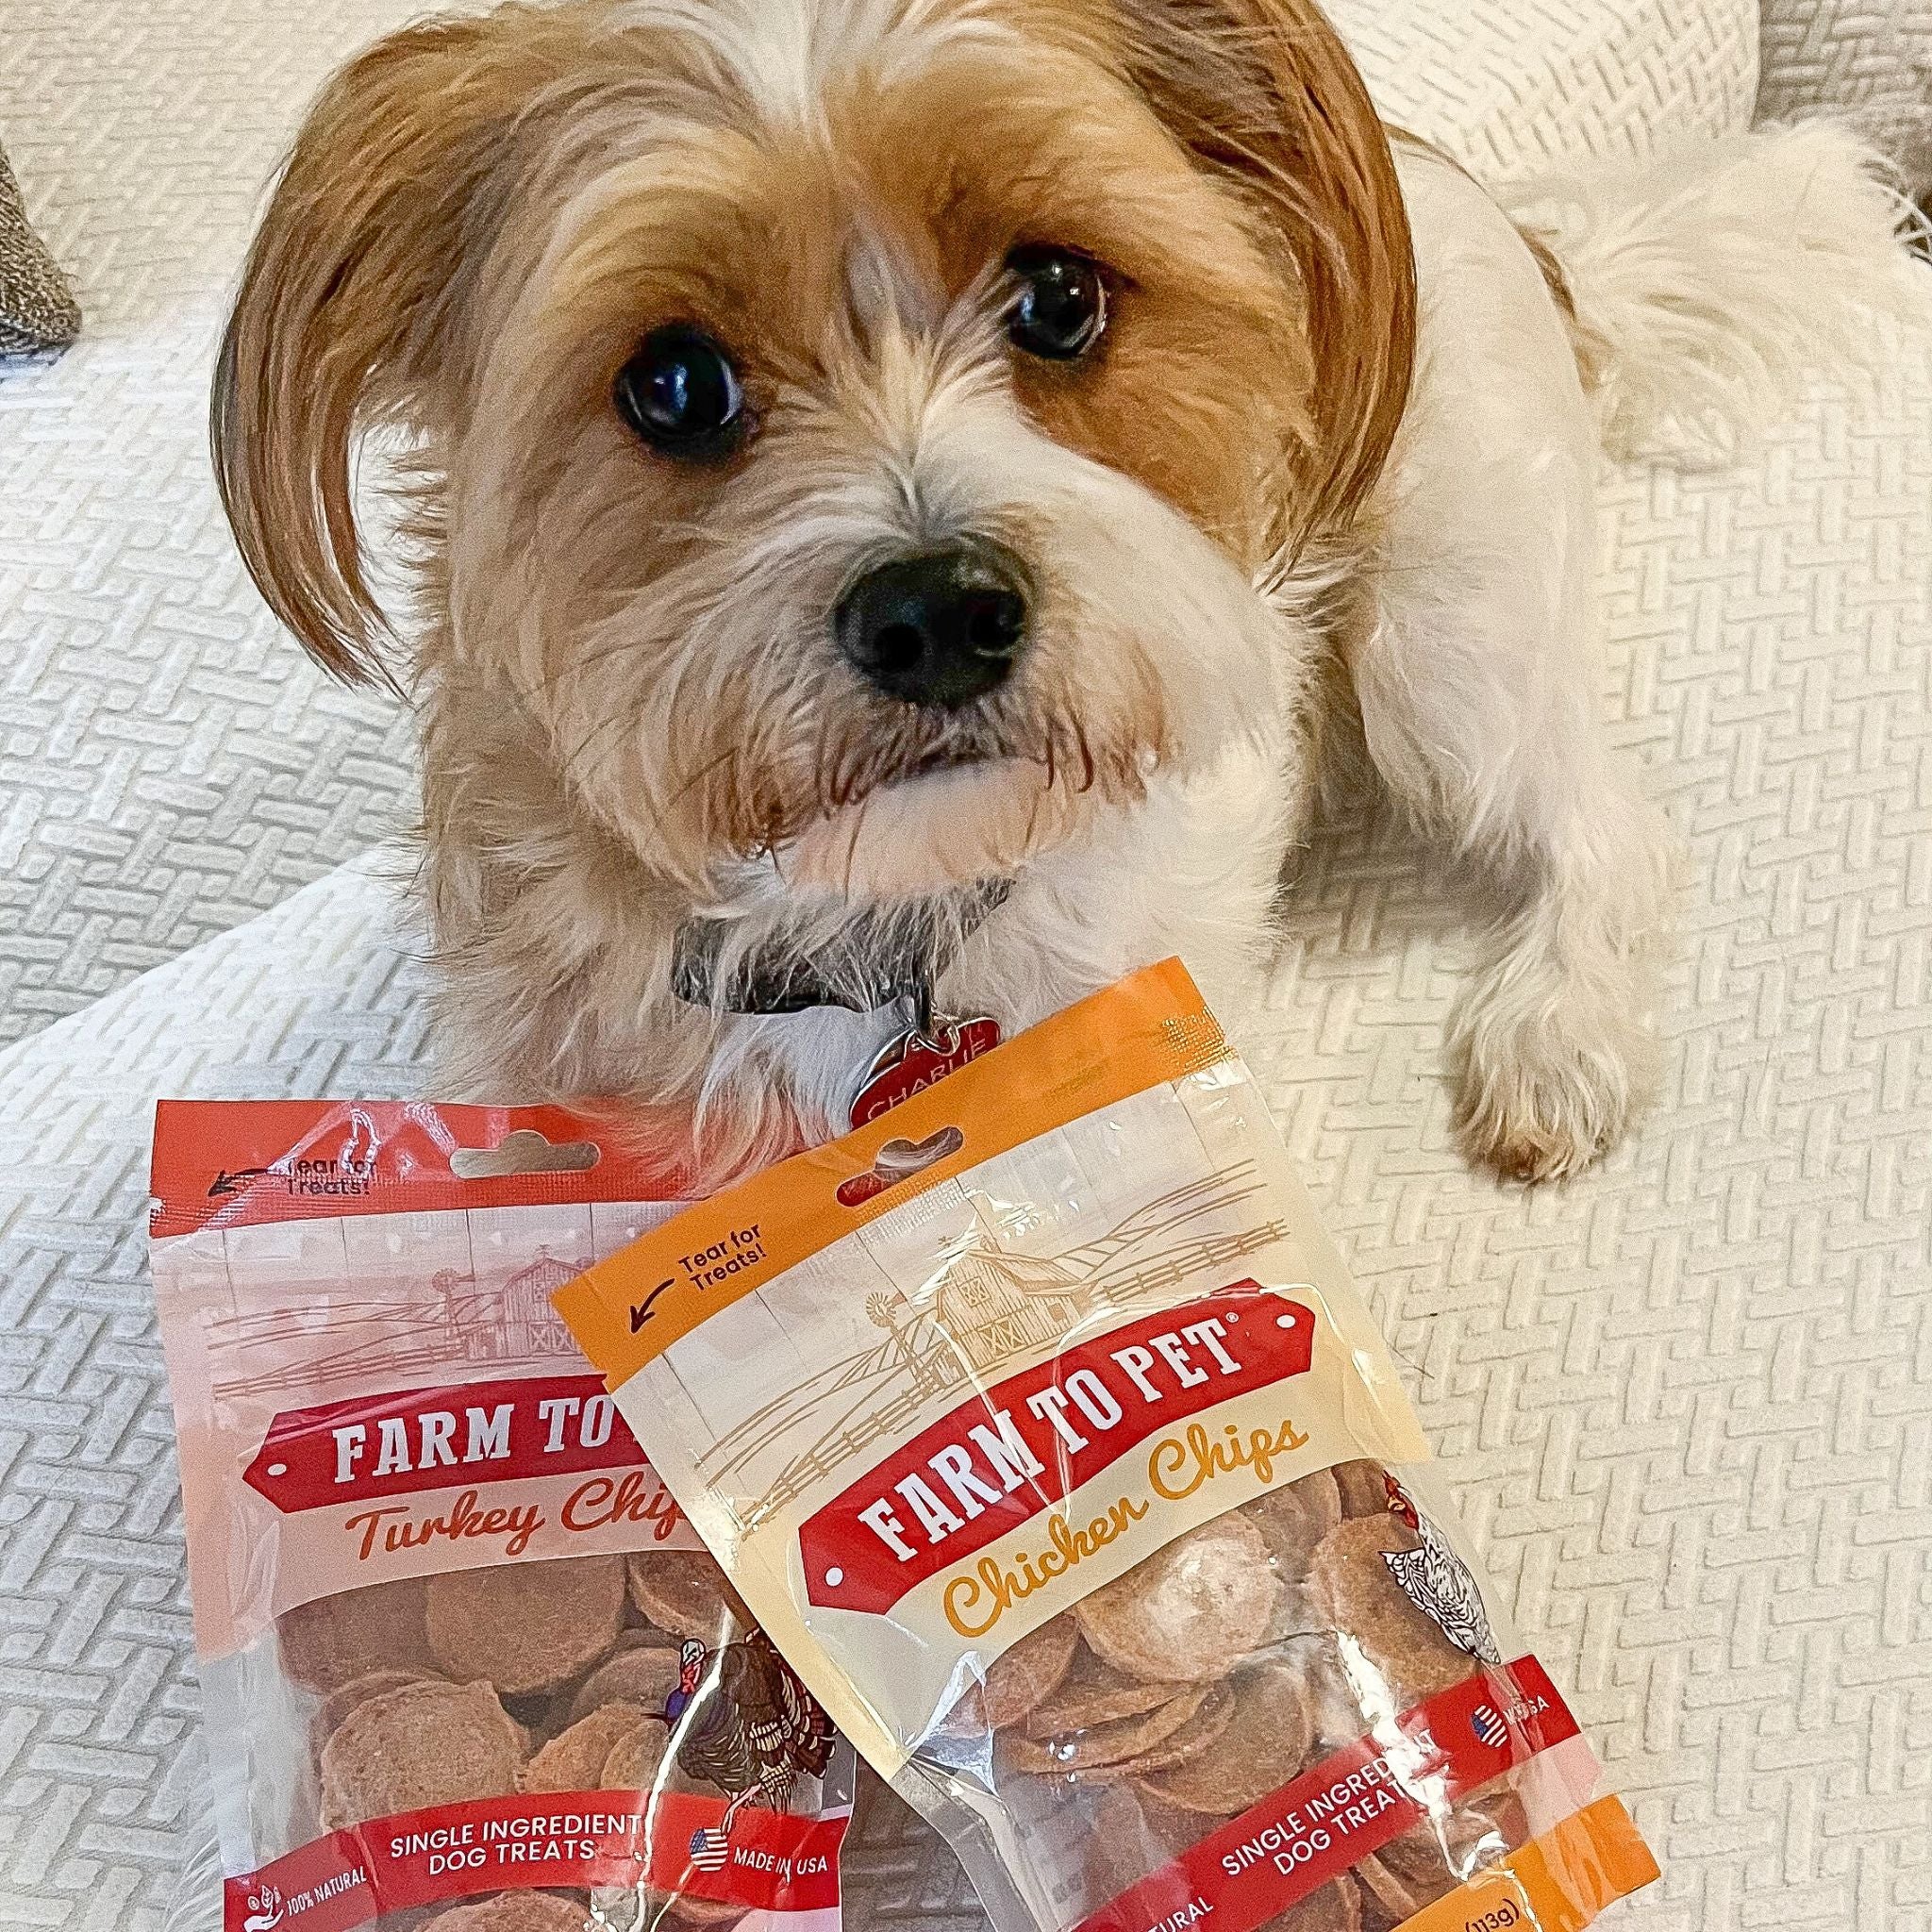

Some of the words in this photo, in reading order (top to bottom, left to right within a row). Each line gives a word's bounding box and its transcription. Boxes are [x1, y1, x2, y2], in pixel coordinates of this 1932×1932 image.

[678, 1241, 727, 1273] Tear
[730, 1224, 761, 1248] for
[689, 1242, 767, 1291] Treats!
[332, 1404, 515, 1484] FARM
[539, 1393, 615, 1453] TO
[858, 1408, 1045, 1562] FARM
[1025, 1368, 1124, 1455] TO
[345, 1490, 546, 1560] Turkey
[561, 1471, 687, 1541] Chip
[942, 1494, 1149, 1638] Chicken
[1148, 1419, 1309, 1501] Chips
[391, 1824, 474, 1857] SINGLE
[482, 1814, 642, 1841] INGREDIENT
[1222, 1812, 1306, 1875] SINGLE
[1274, 1829, 1331, 1875] DOG
[1330, 1777, 1408, 1835] TREAT
[429, 1847, 487, 1875] DOG
[495, 1840, 595, 1864] TREATS
[734, 1846, 774, 1872] MADE
[775, 1857, 791, 1877] IN
[796, 1856, 827, 1875] USA
[287, 1890, 314, 1917] 100%
[314, 1865, 367, 1904] NATURAL
